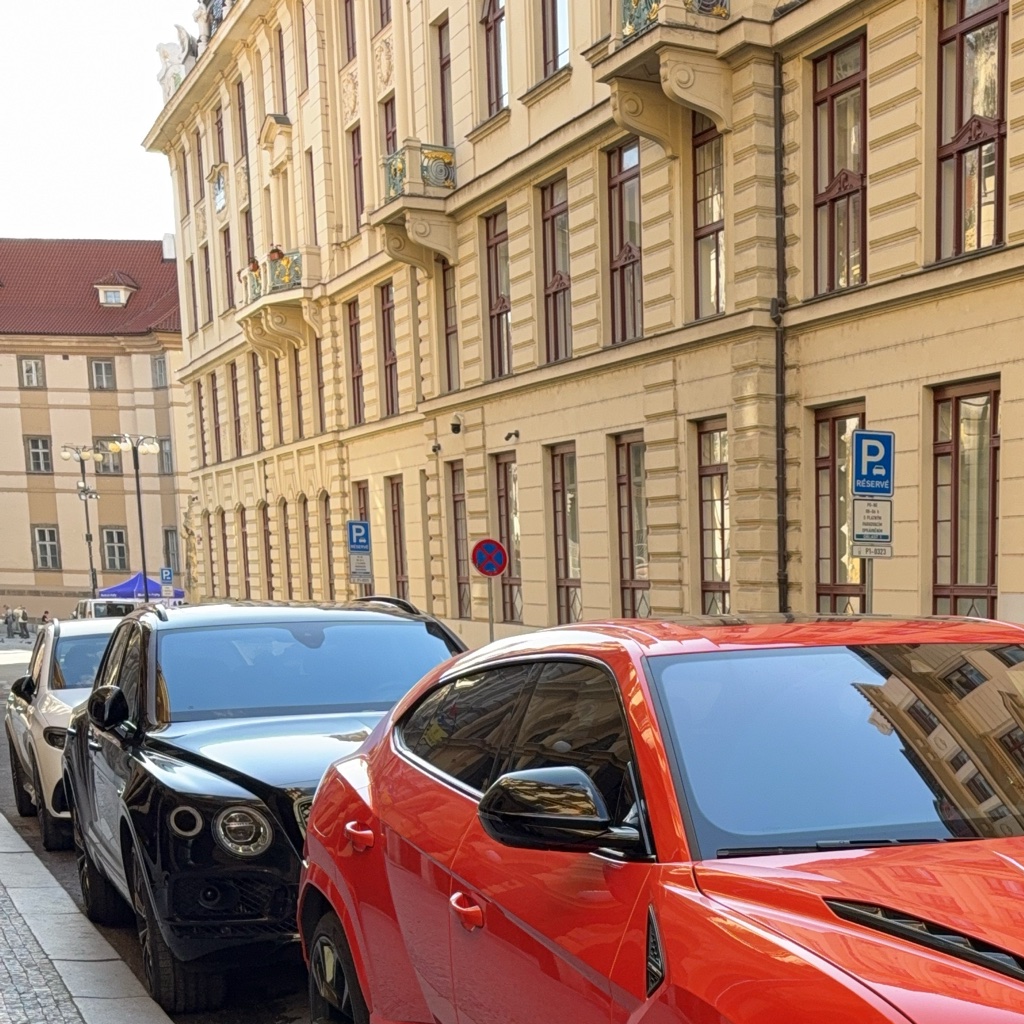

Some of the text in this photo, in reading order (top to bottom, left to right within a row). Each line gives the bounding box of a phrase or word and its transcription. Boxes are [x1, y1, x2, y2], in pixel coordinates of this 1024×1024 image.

[861, 439, 885, 475] P
[856, 478, 890, 489] RÉSERVÉ
[352, 525, 365, 543] P
[162, 570, 170, 580] P
